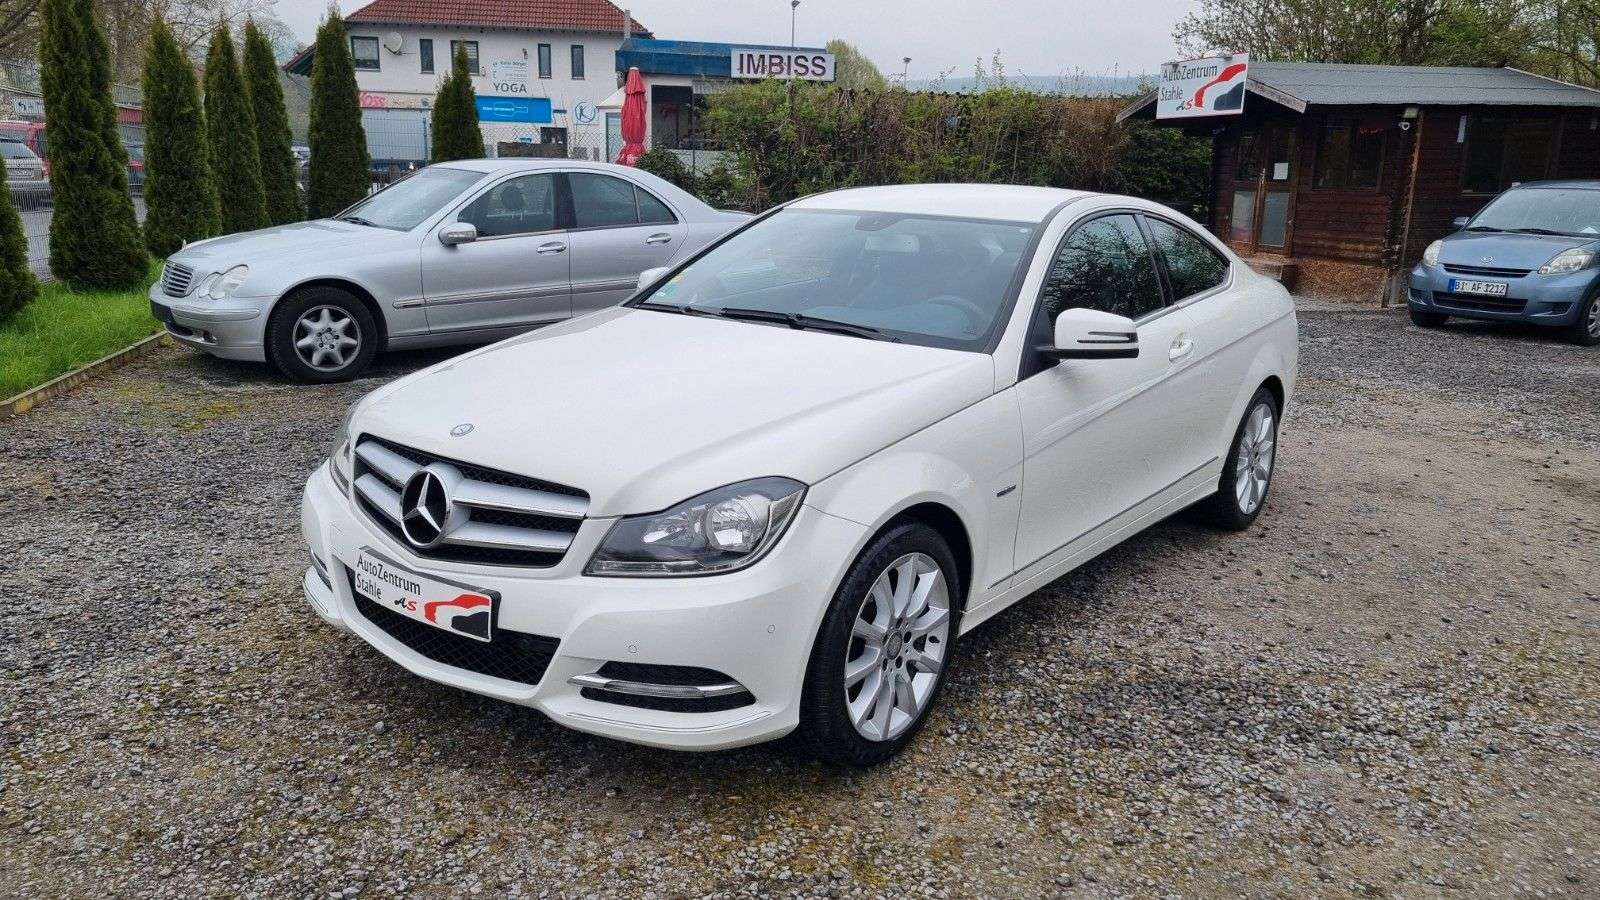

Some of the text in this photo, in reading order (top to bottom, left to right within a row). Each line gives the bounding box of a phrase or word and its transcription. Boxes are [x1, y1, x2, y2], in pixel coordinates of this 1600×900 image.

[739, 53, 826, 77] IMBISS
[1162, 65, 1218, 82] AutoZentrum
[493, 82, 527, 93] YOGA
[1160, 86, 1184, 101] Stahle
[357, 554, 421, 596] AutoZentrum
[356, 574, 382, 600] Stahle
[394, 597, 417, 612] AS
